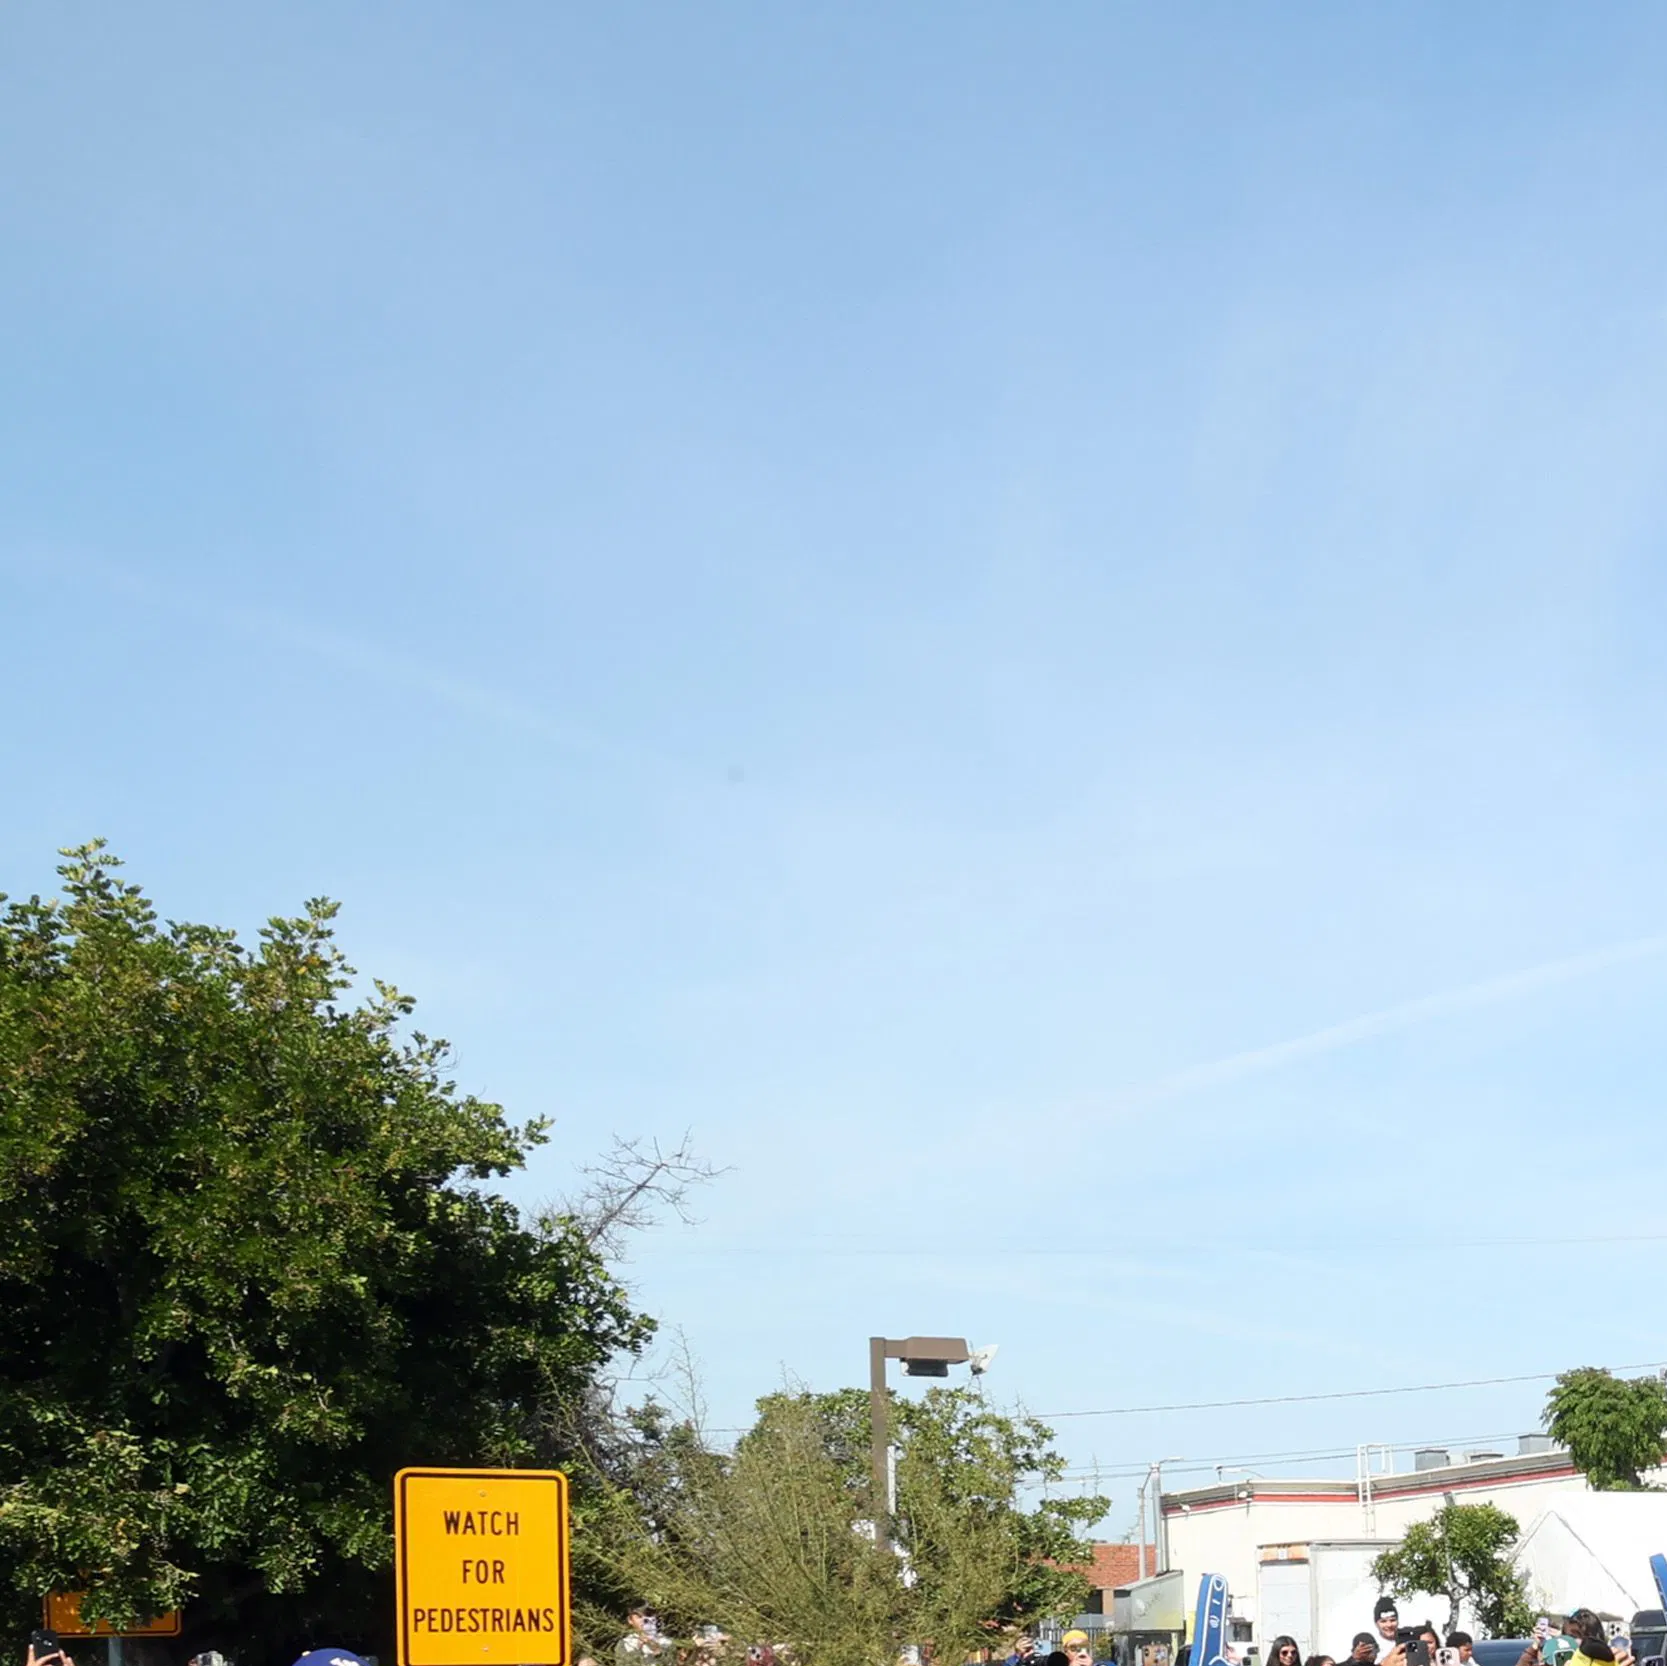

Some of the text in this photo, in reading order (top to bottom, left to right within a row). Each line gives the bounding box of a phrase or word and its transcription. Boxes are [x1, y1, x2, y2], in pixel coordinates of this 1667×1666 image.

[443, 1511, 519, 1536] WATCH
[462, 1559, 505, 1584] FOR
[413, 1607, 555, 1633] PEDESTRIANS
